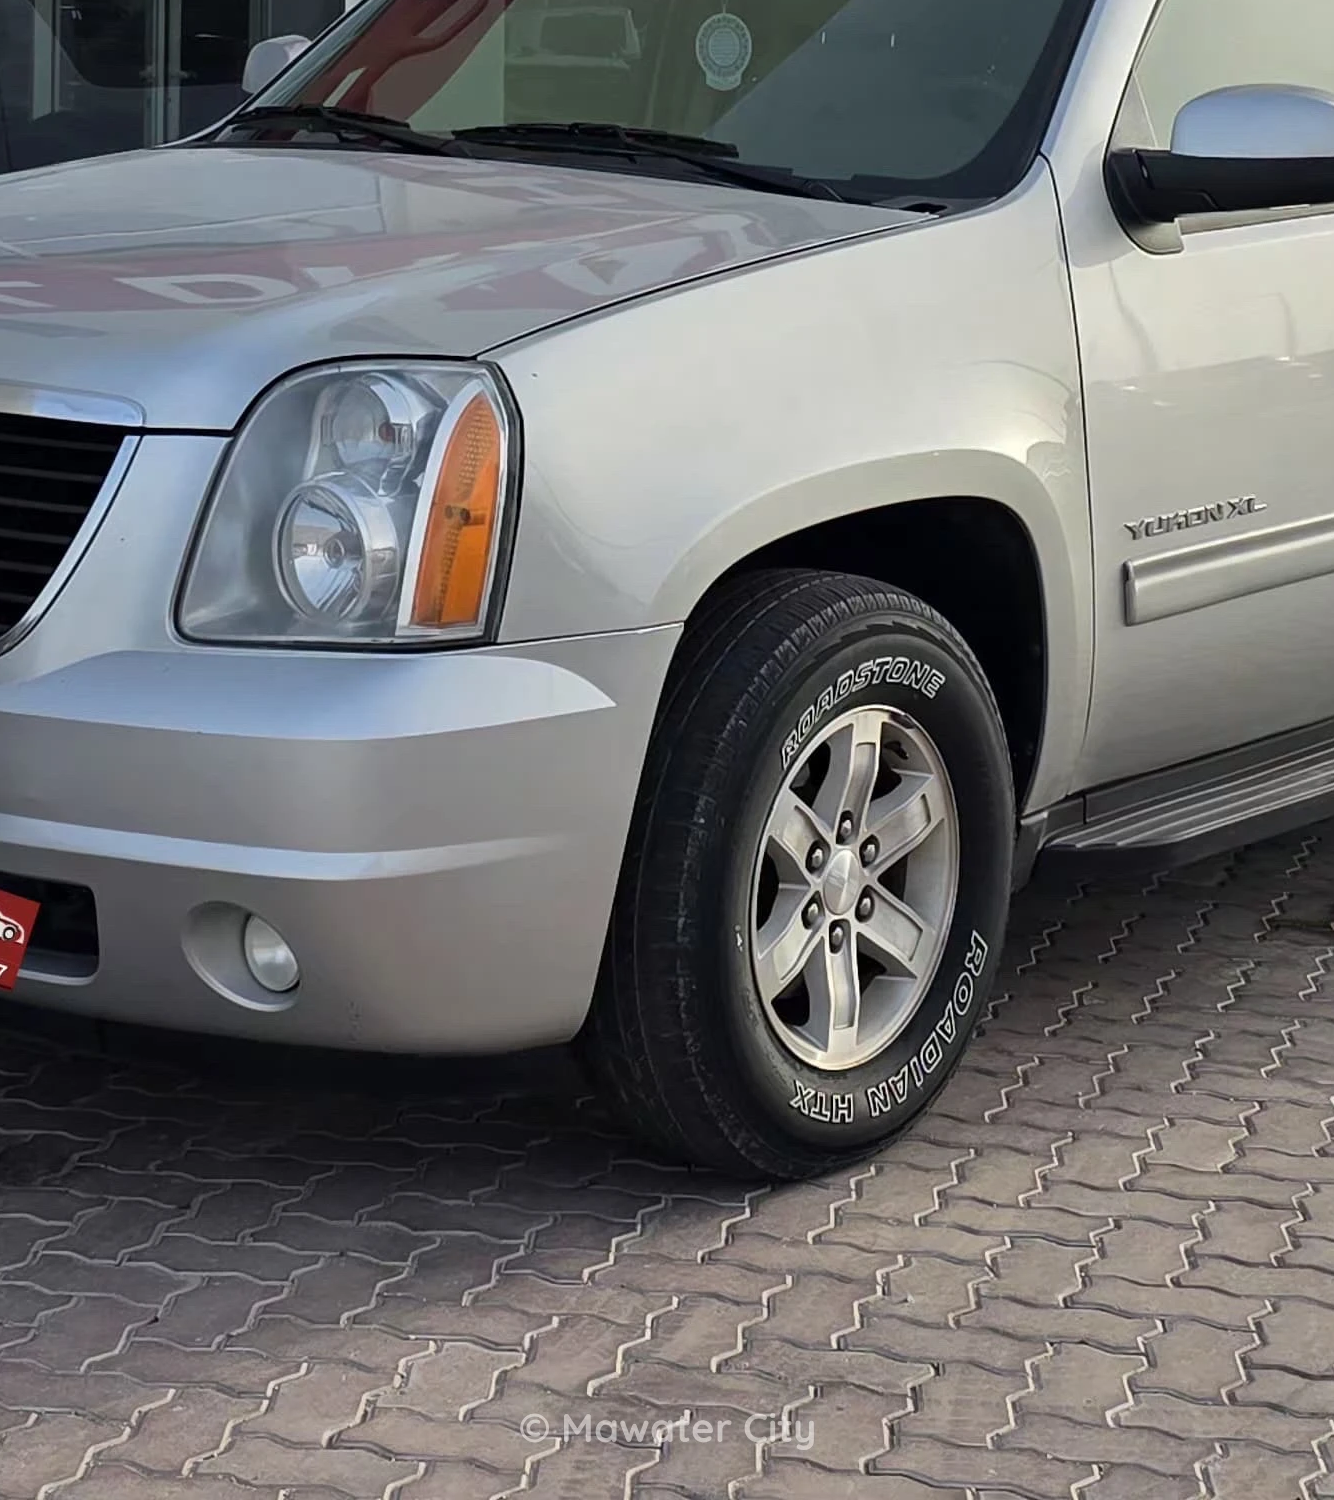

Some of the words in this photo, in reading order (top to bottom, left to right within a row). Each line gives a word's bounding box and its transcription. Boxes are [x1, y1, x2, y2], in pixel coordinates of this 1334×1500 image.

[1124, 501, 1224, 540] YUKON
[1226, 493, 1267, 519] XL
[781, 656, 946, 766] ROADSTONE
[868, 930, 989, 1118] ROADIAN
[790, 1078, 854, 1123] HTX
